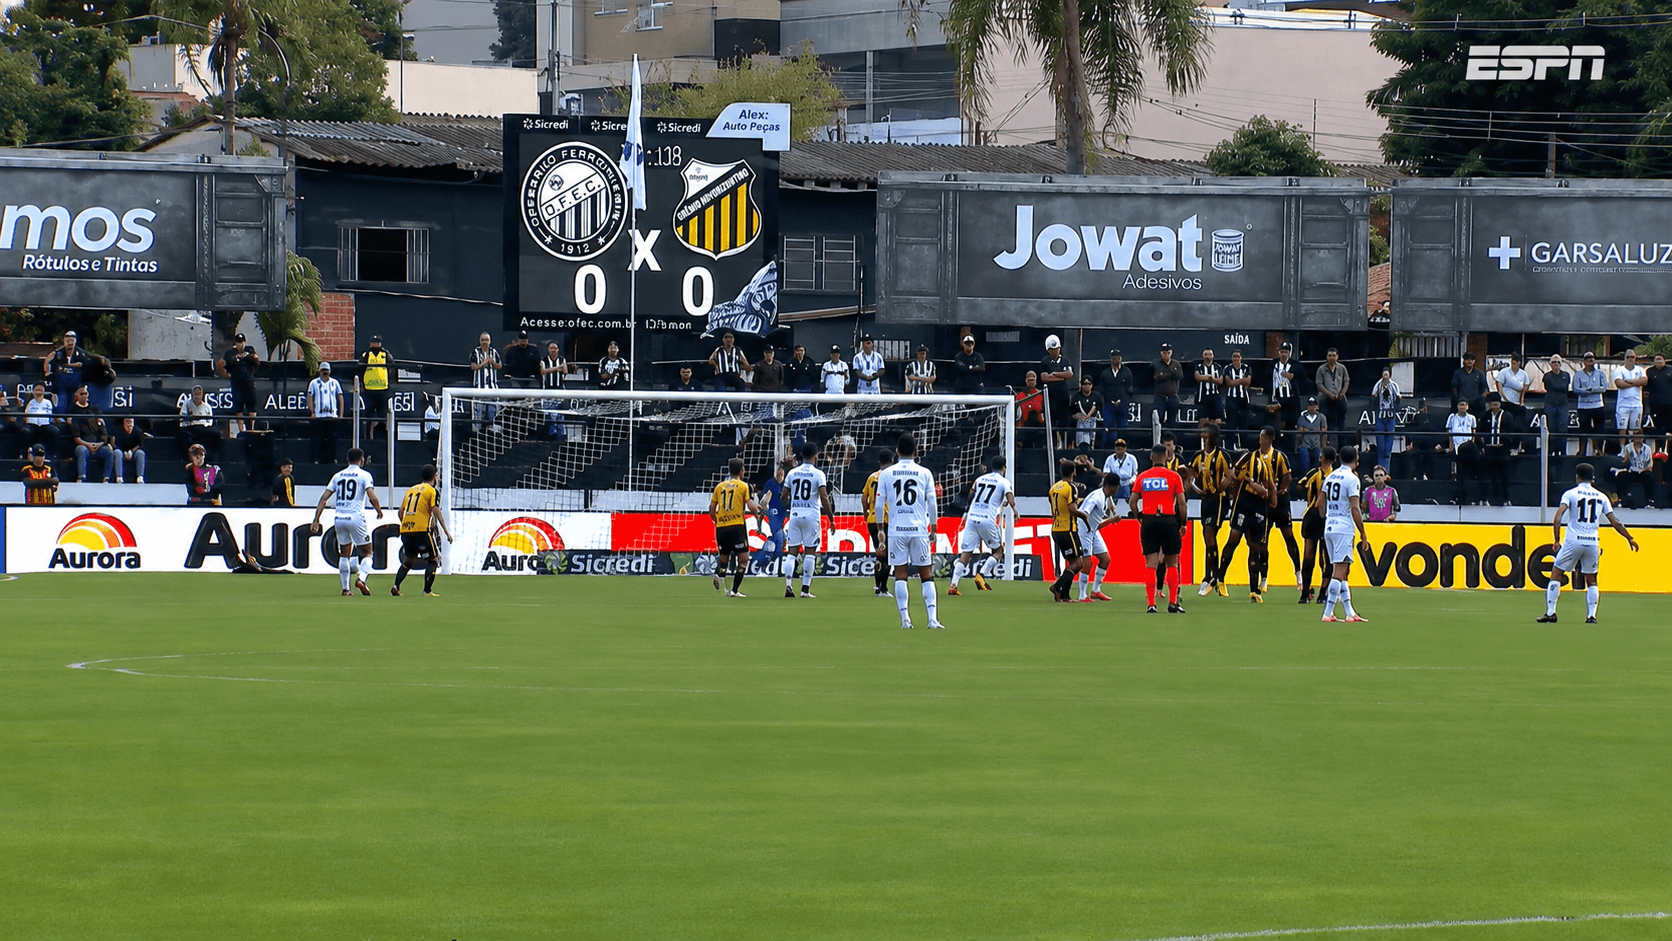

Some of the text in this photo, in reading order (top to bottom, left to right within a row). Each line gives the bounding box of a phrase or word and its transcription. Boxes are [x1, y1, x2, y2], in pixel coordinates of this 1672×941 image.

[534, 118, 569, 130] Sicredi
[738, 109, 768, 120] Alex:
[602, 120, 626, 131] Sicre
[668, 121, 701, 133] Sicredi
[723, 121, 780, 134] Auto Peças
[561, 243, 590, 254] 1912
[993, 205, 1203, 272] Jowat
[1531, 241, 1672, 264] GARSALUZ
[23, 254, 158, 272] Rótulos e Tintas
[574, 264, 714, 316] 0 0
[1122, 274, 1202, 290] Adesivos
[1224, 332, 1250, 345] SAÍDA
[336, 479, 357, 501] 19
[893, 479, 917, 506] 16
[975, 483, 996, 504] 77
[1326, 482, 1341, 502] 19
[184, 512, 428, 570] Auror
[49, 548, 141, 569] Aurora
[571, 553, 654, 573] Sicredi
